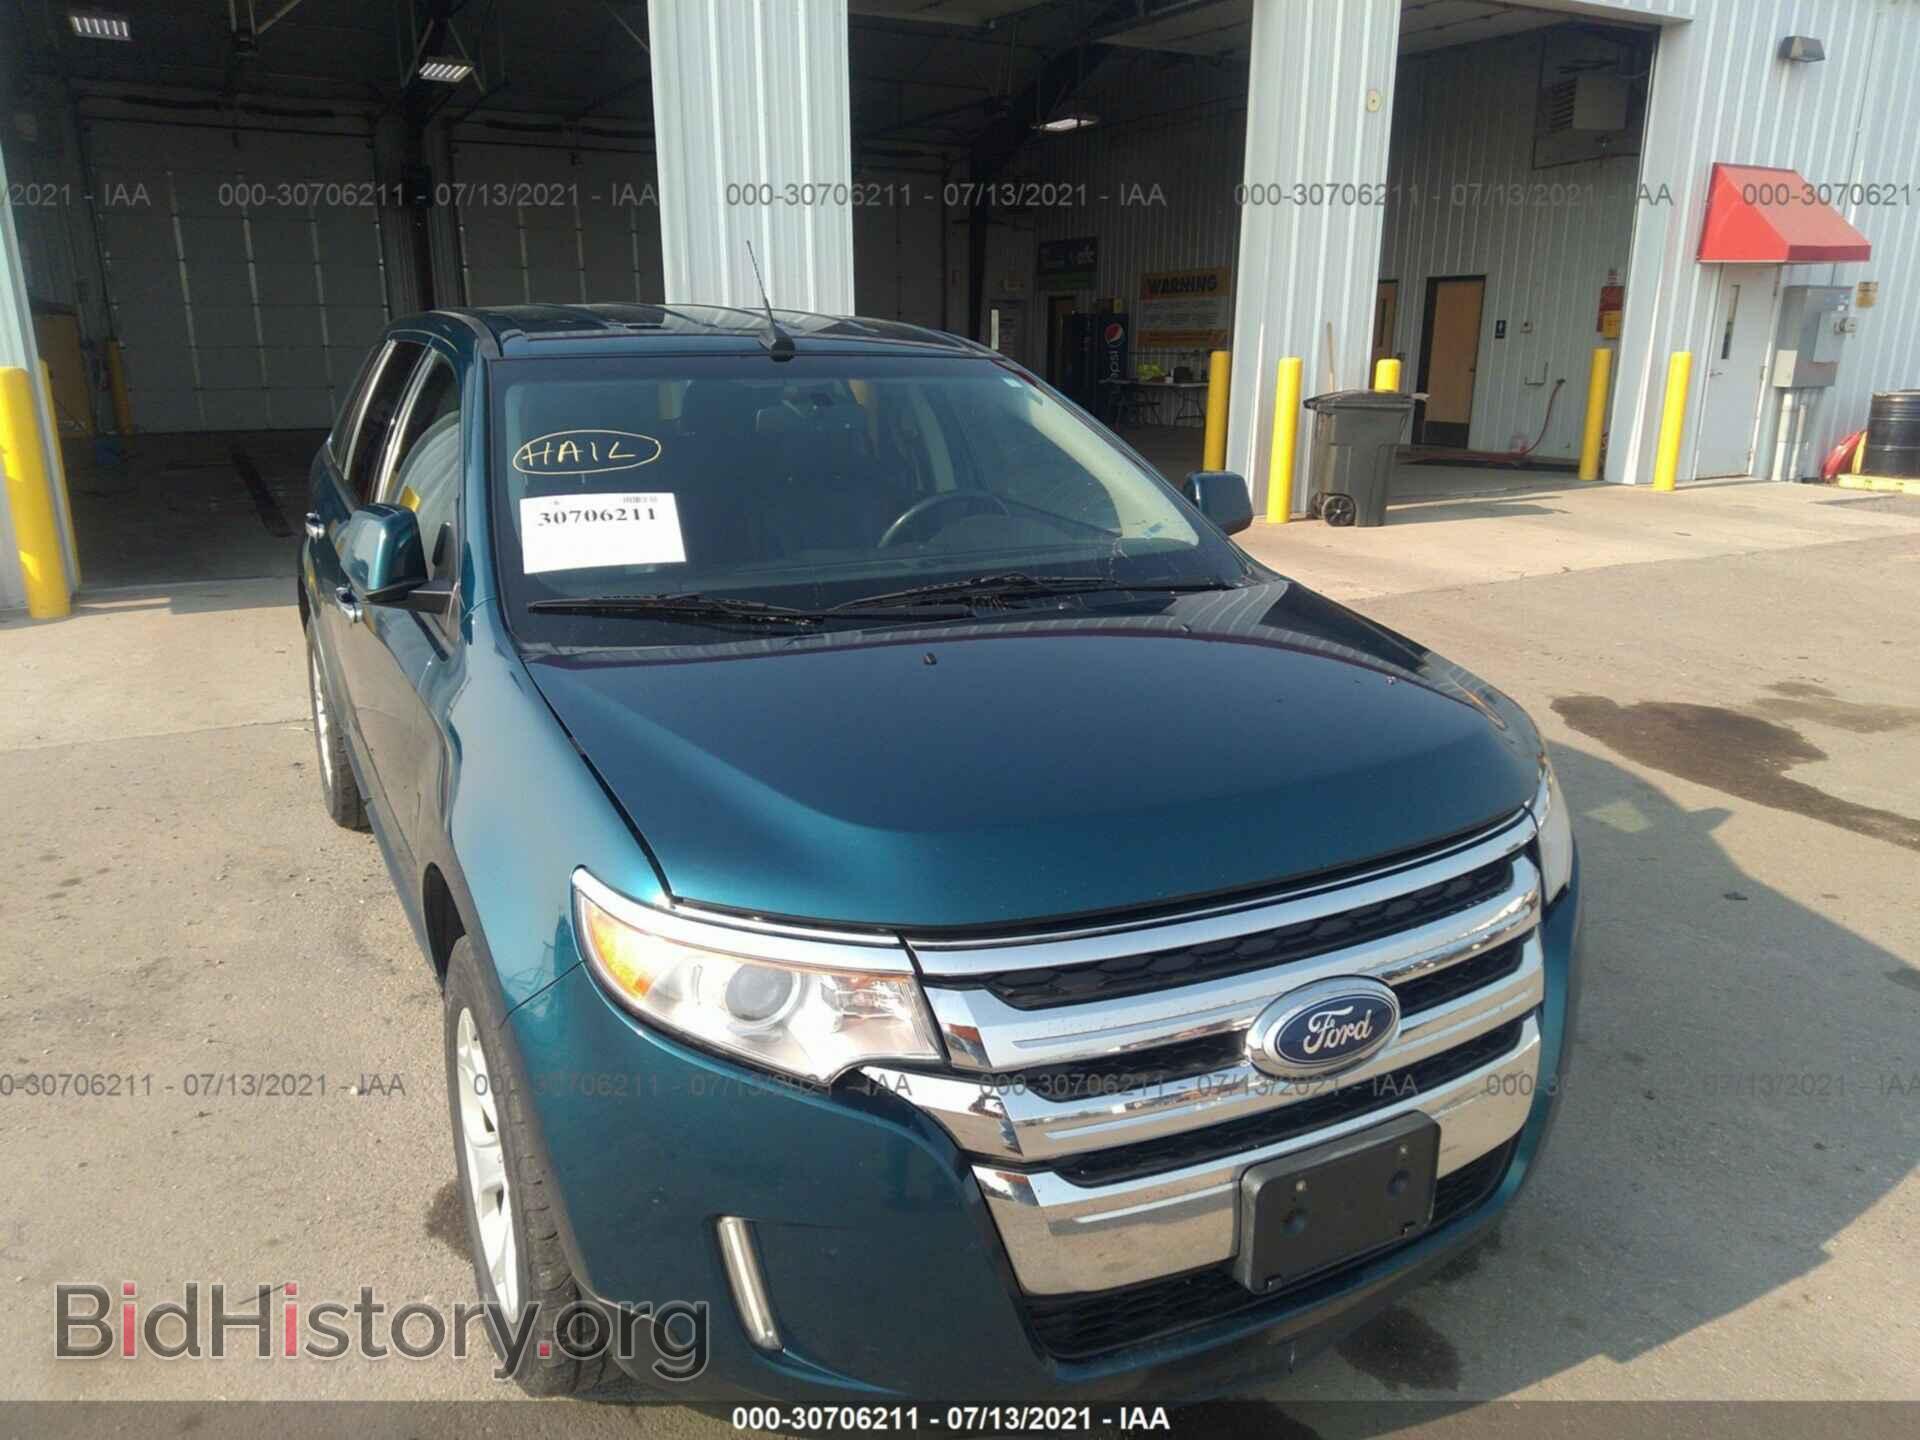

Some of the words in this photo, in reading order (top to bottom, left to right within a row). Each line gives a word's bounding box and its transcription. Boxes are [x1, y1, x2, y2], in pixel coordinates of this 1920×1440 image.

[1148, 274, 1217, 294] WARNING
[522, 440, 636, 467] HAIL
[537, 507, 657, 528] 30706211
[1303, 1006, 1373, 1054] Ford
